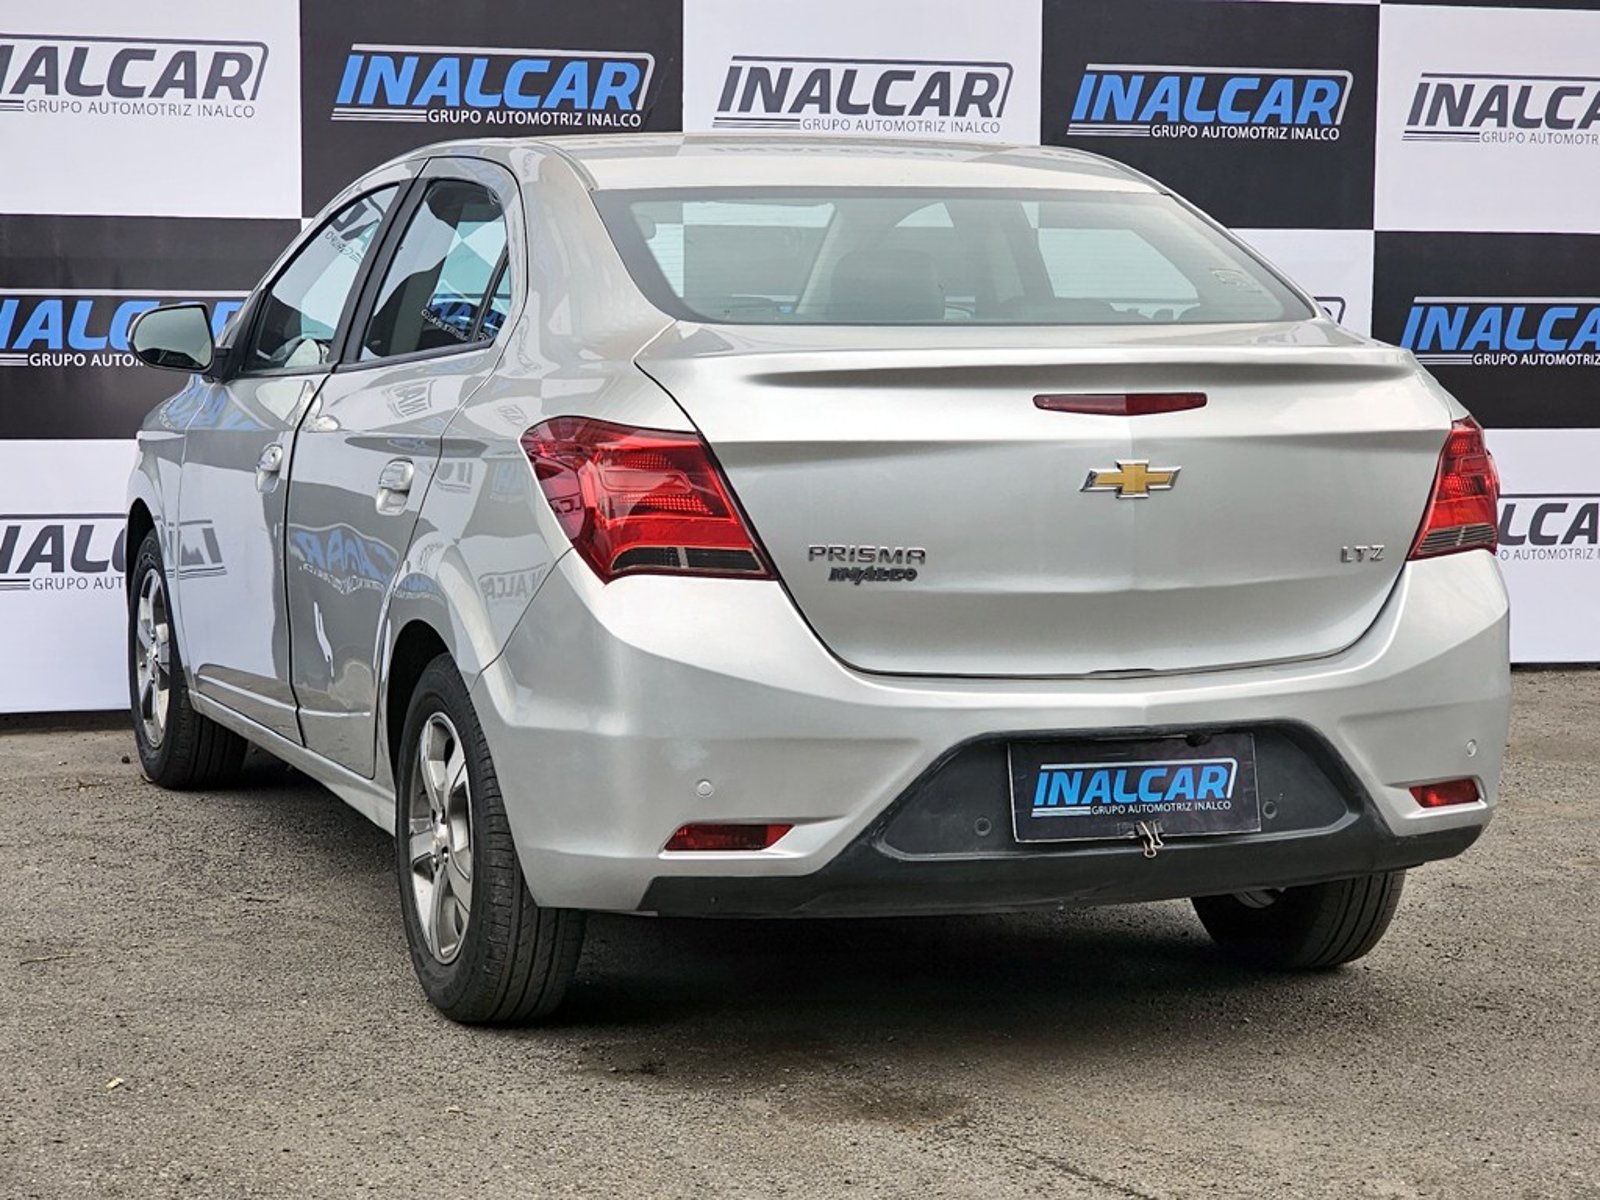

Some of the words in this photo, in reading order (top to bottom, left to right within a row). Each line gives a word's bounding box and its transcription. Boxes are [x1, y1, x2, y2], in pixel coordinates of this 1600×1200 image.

[336, 54, 642, 111] INALCAR
[717, 65, 1000, 118] INALCAR
[1071, 74, 1341, 125] INALCAR
[26, 100, 82, 114] GRUPO
[88, 102, 192, 117] AUTOMOTRIZ
[198, 104, 255, 118] INALCO
[427, 108, 482, 124] GRUPO
[486, 111, 583, 127] AUTOMOTRIZ
[587, 112, 642, 128] INALCO
[802, 118, 851, 131] GRUPO
[855, 119, 946, 133] AUTOMOTRIZ
[950, 120, 1000, 134] INALCO
[1151, 124, 1199, 138] GRUPO
[1201, 125, 1287, 139] AUTOMOTRIZ
[1291, 127, 1340, 141] INALCO
[1481, 131, 1525, 144] GRUPO
[29, 353, 87, 367] GRUPO
[1473, 353, 1517, 366] GRUPO
[808, 544, 926, 565] PRISMA
[1340, 545, 1385, 563] LTZ
[1513, 548, 1594, 560] AUTOMOTRIZ
[32, 577, 89, 591] GRUPO
[1034, 765, 1229, 806] INALCAR
[1091, 804, 1126, 816] GRUPO
[1128, 802, 1192, 814] AUTOMOTRIZ
[1194, 800, 1232, 811] INALCO
